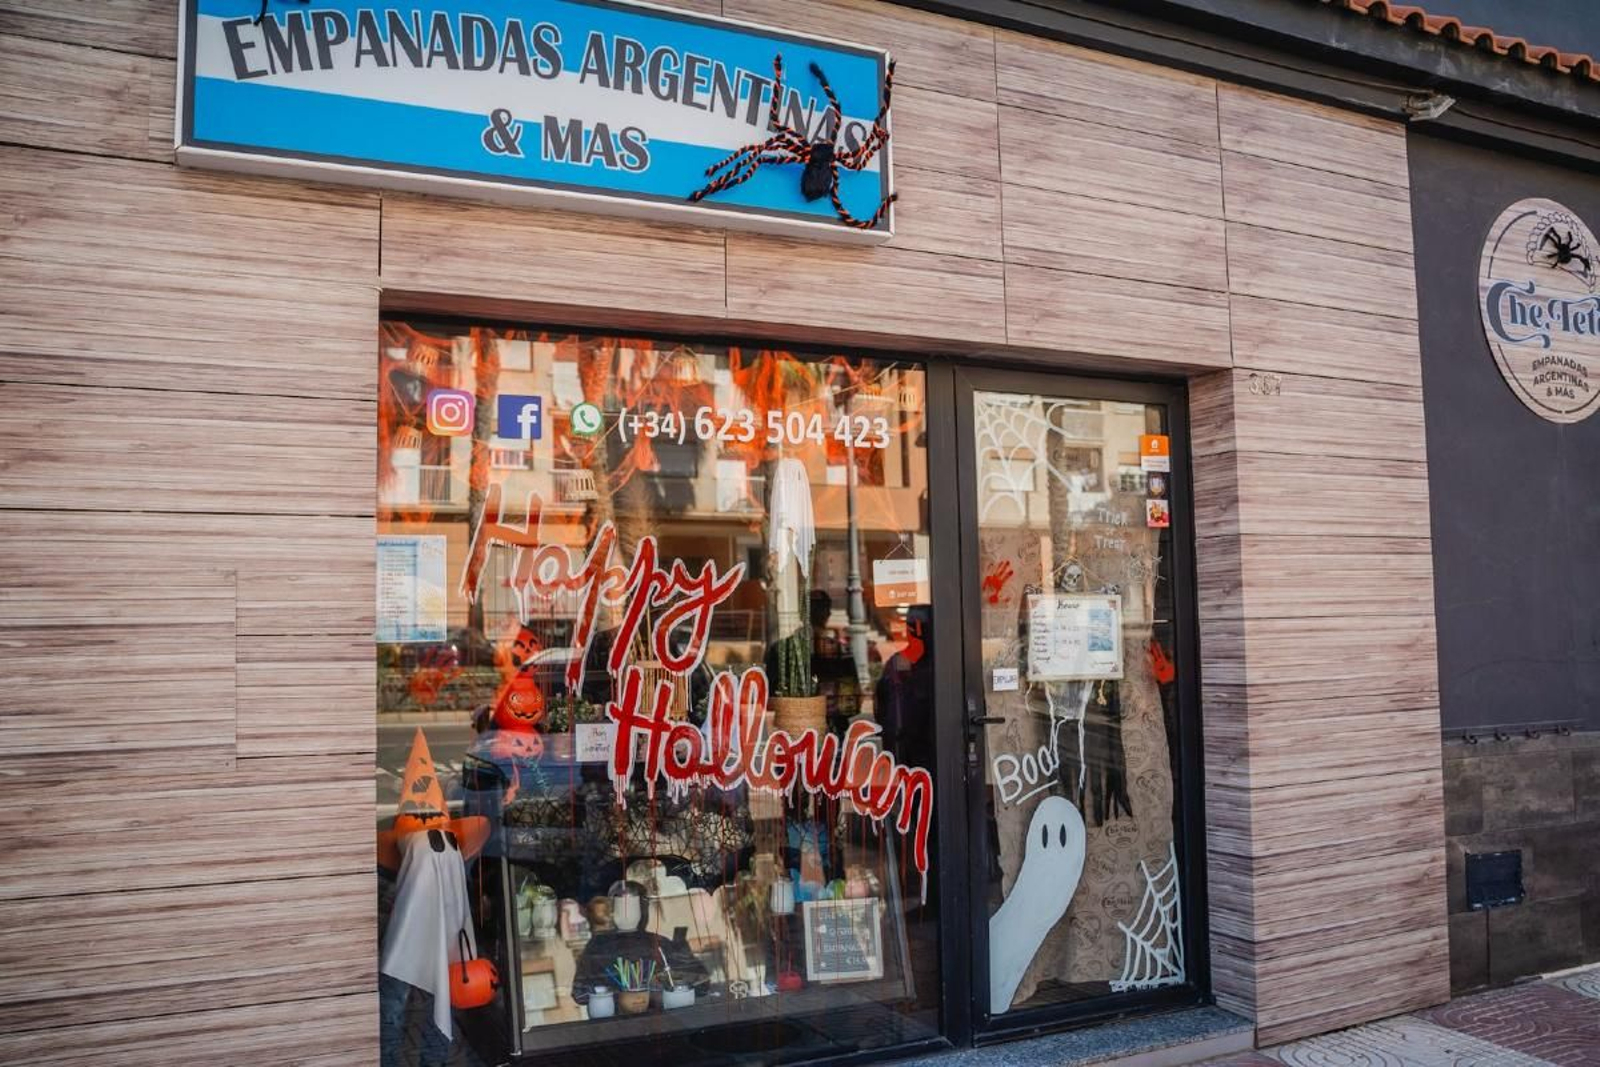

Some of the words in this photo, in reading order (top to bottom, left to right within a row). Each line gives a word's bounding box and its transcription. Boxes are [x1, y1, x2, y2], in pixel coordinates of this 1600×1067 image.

[221, 10, 563, 80] EMPANADAS
[579, 32, 867, 162] ARGENTINAS
[482, 108, 524, 156] &
[542, 115, 649, 172] MAS
[1533, 355, 1588, 378] EMPANADAS
[1533, 371, 1589, 393] ARGENTINAS
[1555, 386, 1575, 399] MAS
[618, 407, 686, 445] (+34)
[694, 407, 755, 442] 623
[767, 411, 825, 446] 504
[834, 415, 890, 449] 423
[459, 481, 747, 697] Happy
[606, 665, 934, 885] Halloween
